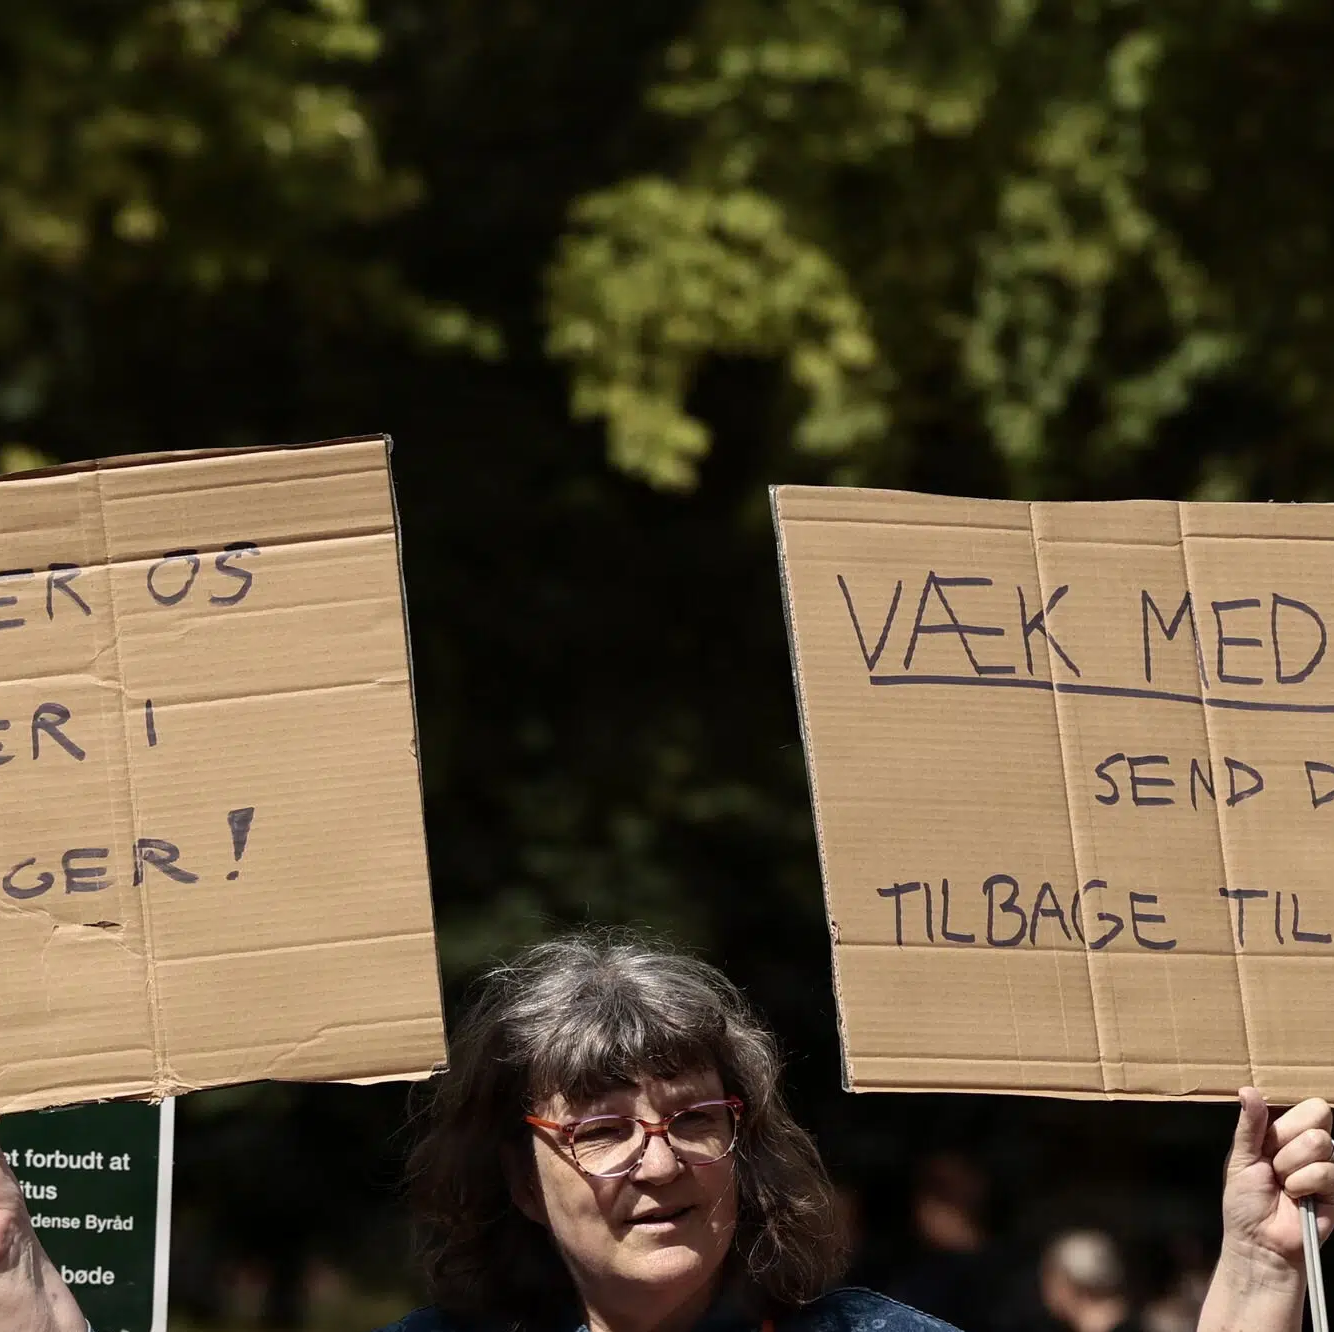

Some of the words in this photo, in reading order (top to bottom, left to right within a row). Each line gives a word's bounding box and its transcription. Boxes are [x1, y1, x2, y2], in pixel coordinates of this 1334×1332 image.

[146, 540, 261, 606] OS
[836, 570, 1082, 680] VÆK
[1140, 588, 1328, 690] MED
[145, 698, 160, 748] I
[1093, 752, 1266, 810] SEND
[876, 874, 1180, 953] TILBAGE
[1217, 885, 1334, 946] TIL
[24, 1149, 104, 1170] forbudt
[108, 1153, 131, 1171] at
[30, 1213, 81, 1229] dense
[85, 1214, 134, 1233] Byråd
[60, 1264, 116, 1286] bøde
